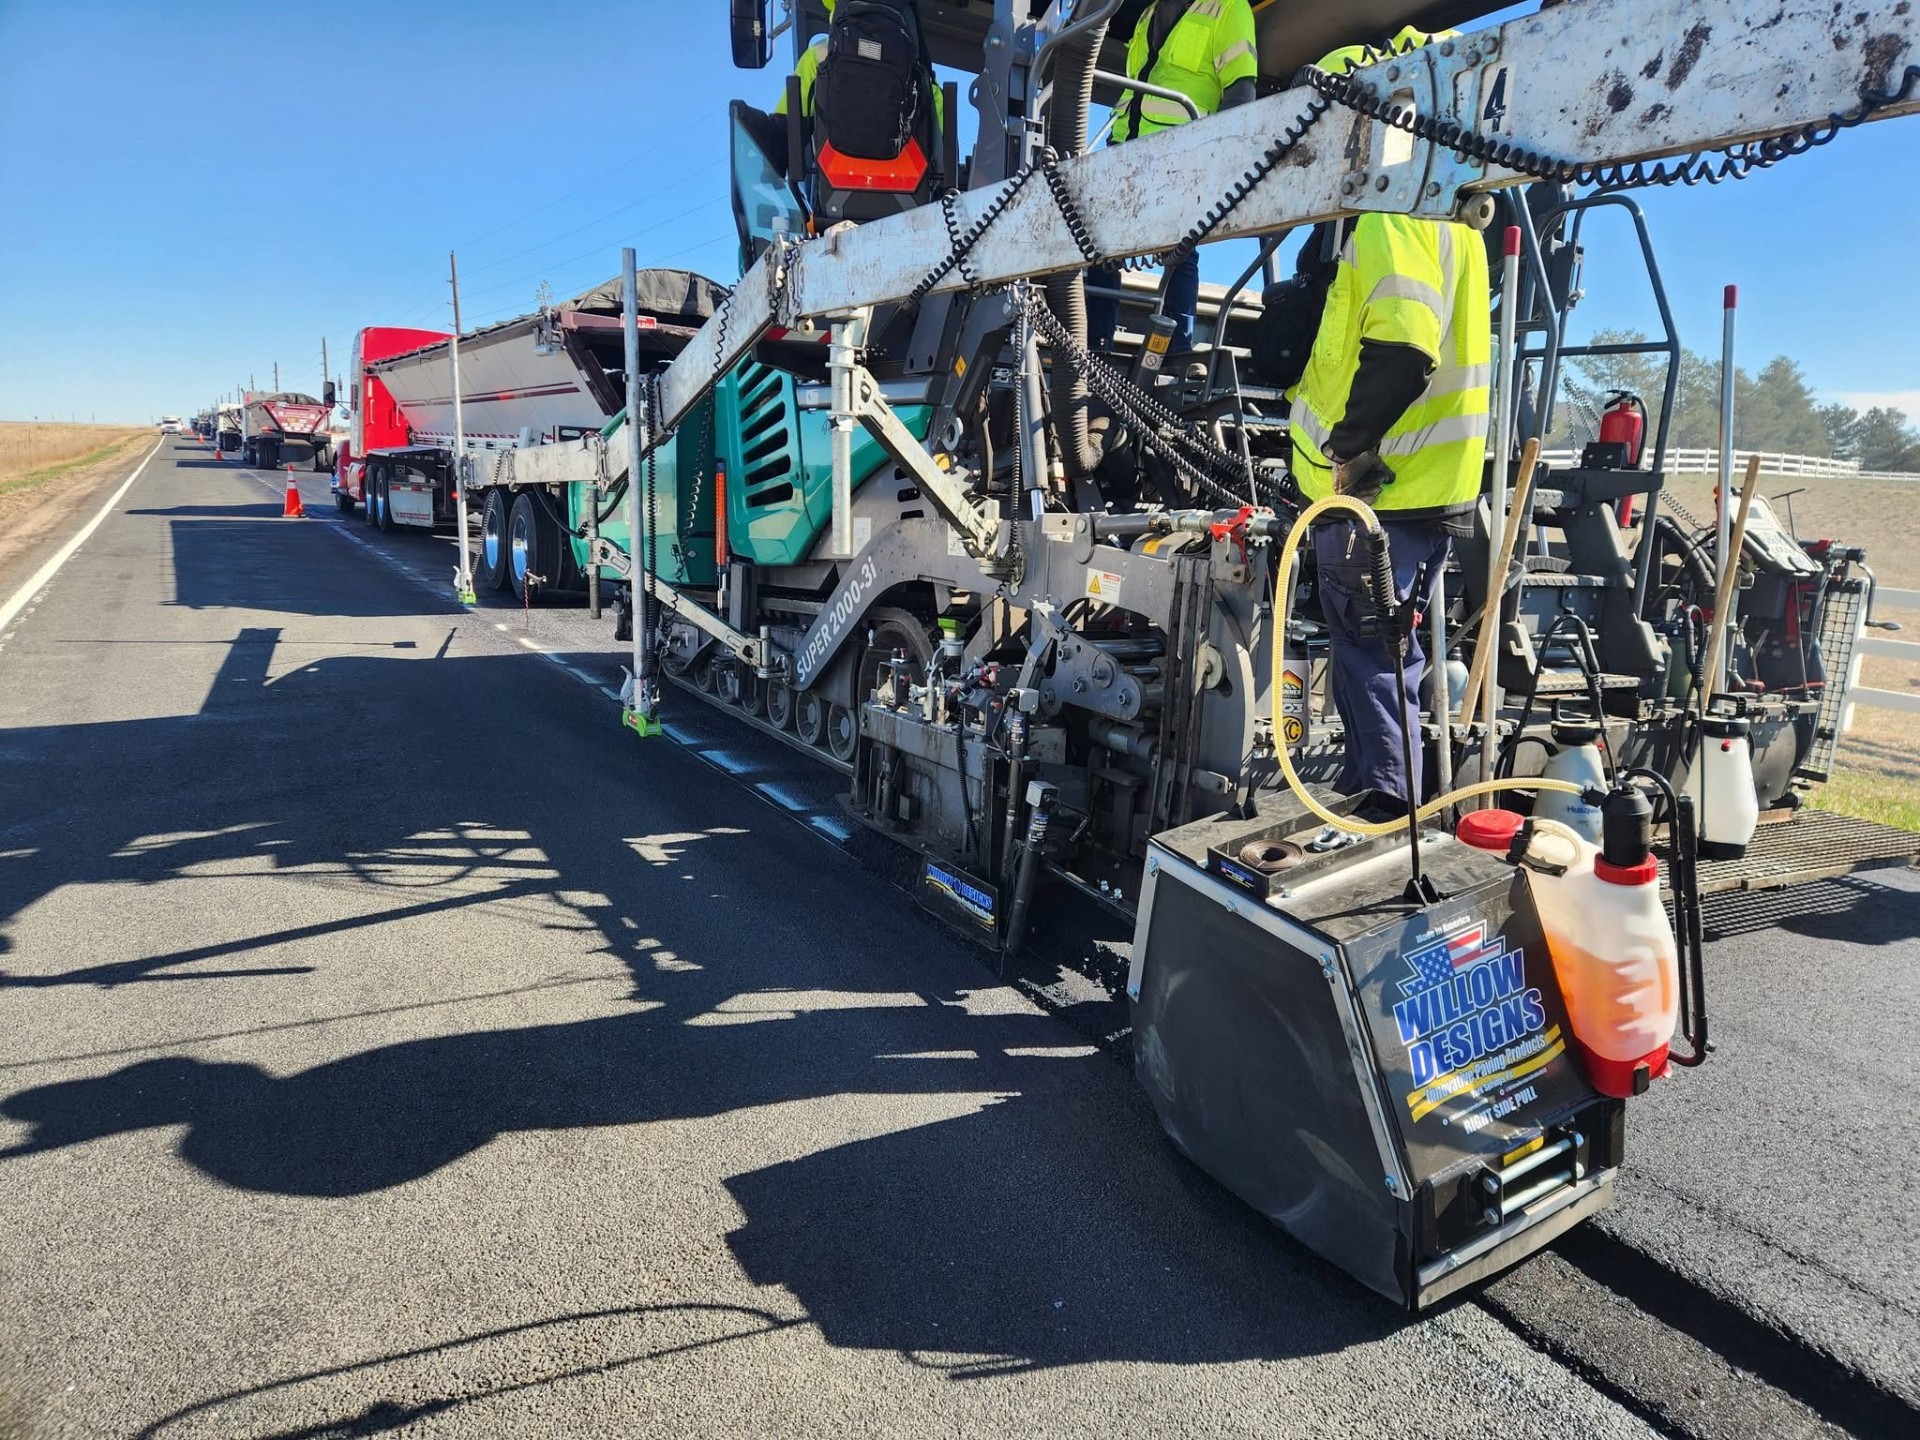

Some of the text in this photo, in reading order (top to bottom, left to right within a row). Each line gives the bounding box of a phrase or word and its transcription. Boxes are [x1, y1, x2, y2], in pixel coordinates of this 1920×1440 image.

[1483, 67, 1508, 133] 4
[796, 623, 832, 682] SUPER
[829, 555, 877, 635] 2000-3i
[961, 882, 993, 911] DESIGNS
[1442, 914, 1471, 932] America
[1392, 947, 1526, 1046] WILLOW
[1408, 987, 1546, 1090] DESIGNS
[1425, 1069, 1475, 1104] Innovative
[1475, 1052, 1507, 1081] Paving
[1505, 1034, 1546, 1066] Products
[1462, 1109, 1495, 1135] RIGHT
[1493, 1096, 1517, 1119] SIDE
[1515, 1085, 1538, 1108] PULL
